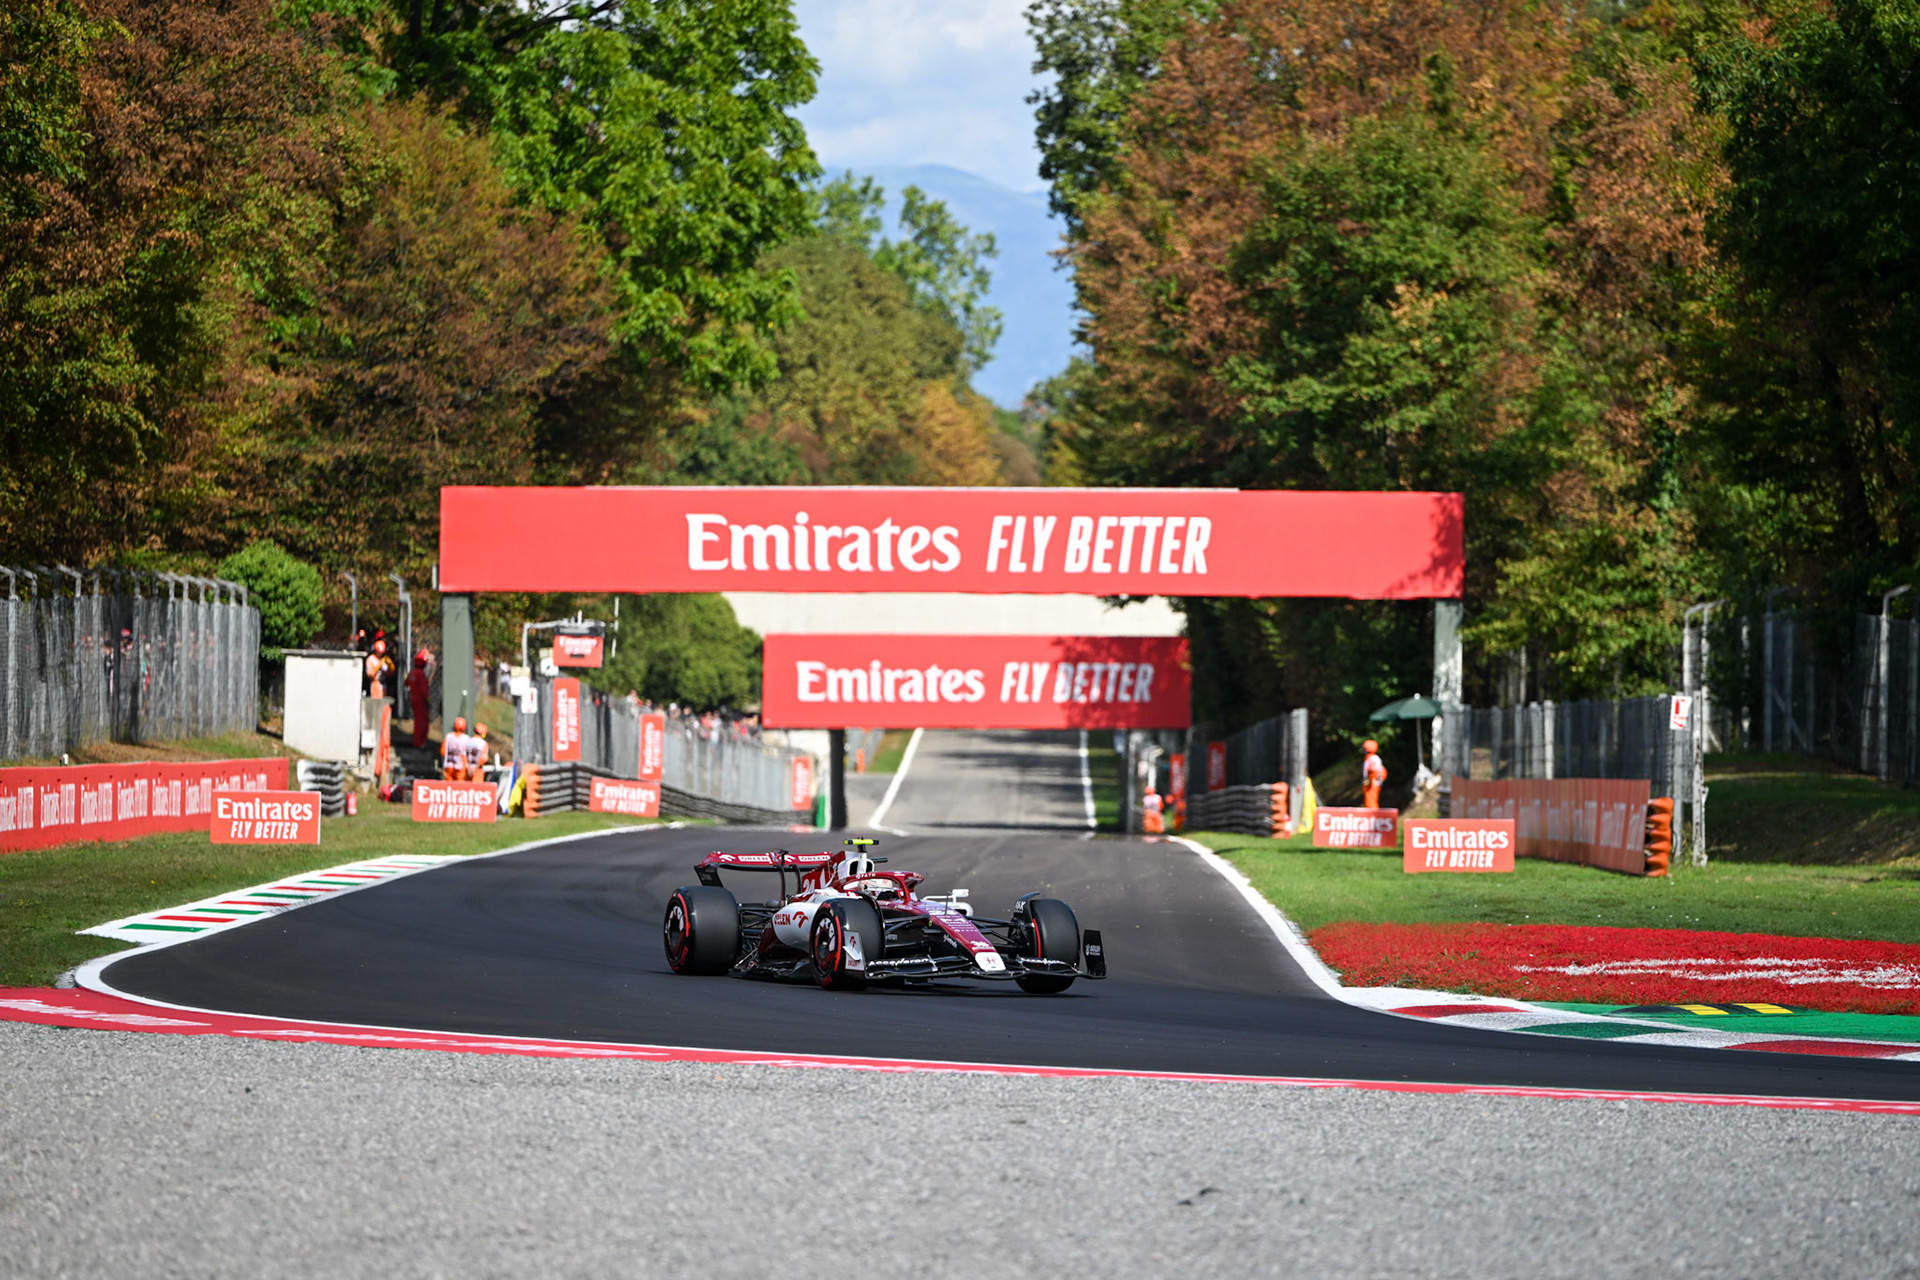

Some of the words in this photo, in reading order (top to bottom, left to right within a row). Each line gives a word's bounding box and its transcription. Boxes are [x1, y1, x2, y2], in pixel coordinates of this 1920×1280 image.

[686, 511, 961, 573] Emirates
[986, 515, 1057, 573] FLY
[1064, 516, 1212, 574] BETTER
[796, 659, 985, 703] Emirates
[1000, 662, 1051, 703] FLY
[1053, 662, 1154, 704] BETTER
[417, 785, 492, 805] Emirates
[595, 783, 656, 803] Emirates
[217, 798, 313, 821] Emirates
[231, 821, 252, 838] FLY
[254, 821, 298, 839] BETTER
[1319, 813, 1393, 831] Emirates
[1328, 832, 1346, 846] FLY
[1411, 827, 1509, 849] Emirates
[1426, 850, 1447, 867] FLY
[1449, 850, 1495, 868] BETTER
